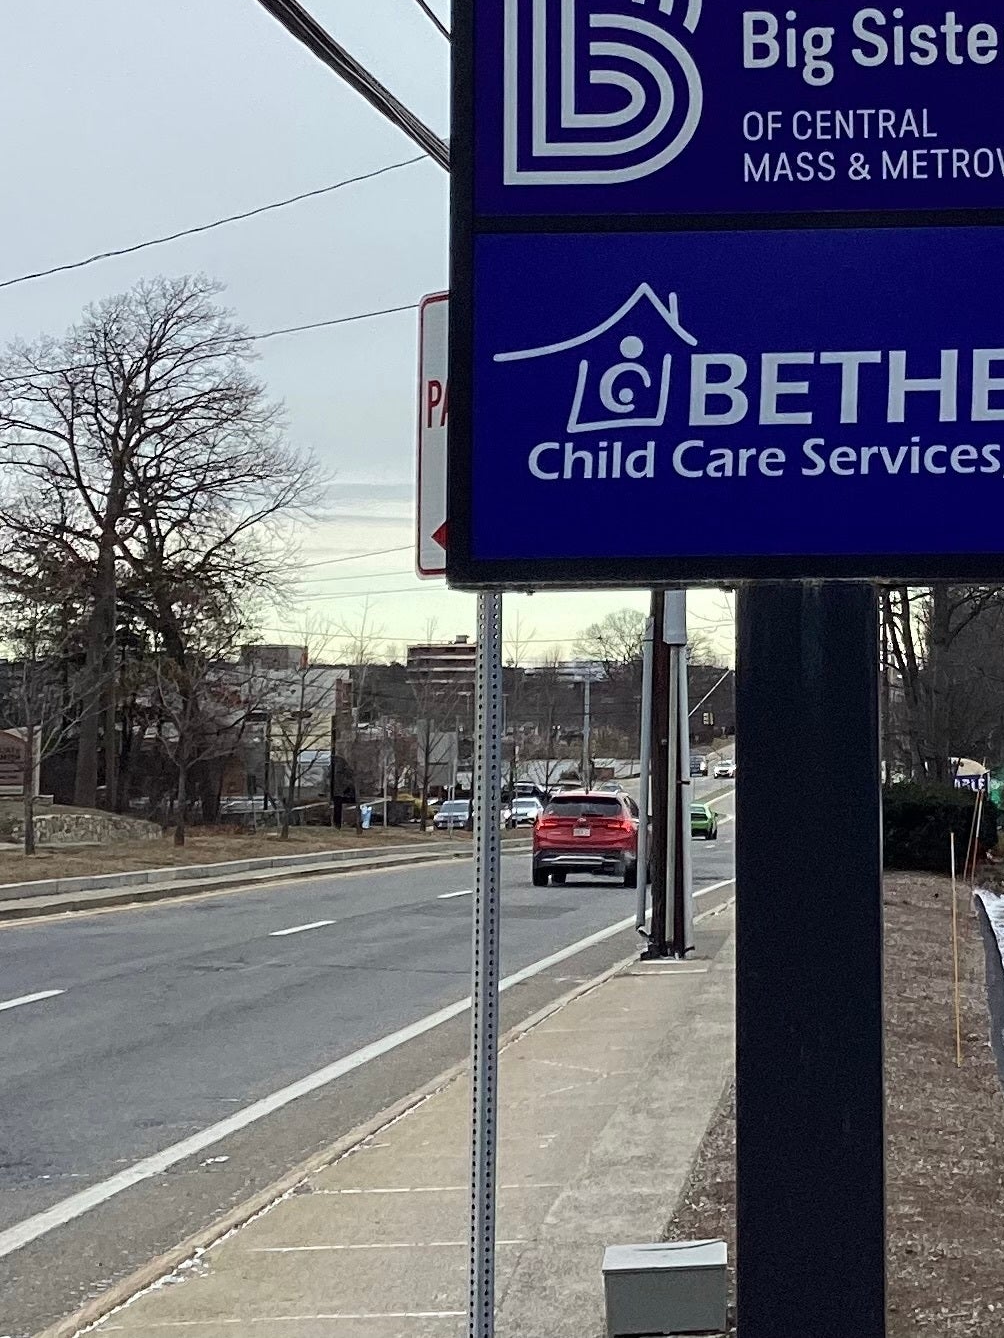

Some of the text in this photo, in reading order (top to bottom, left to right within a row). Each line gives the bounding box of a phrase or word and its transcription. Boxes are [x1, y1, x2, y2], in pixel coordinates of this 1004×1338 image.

[742, 10, 834, 86] Big
[742, 108, 938, 141] OF CENTRAL
[743, 152, 836, 182] MASS
[849, 153, 872, 181] &
[528, 440, 655, 480] Child
[672, 438, 785, 478] Care
